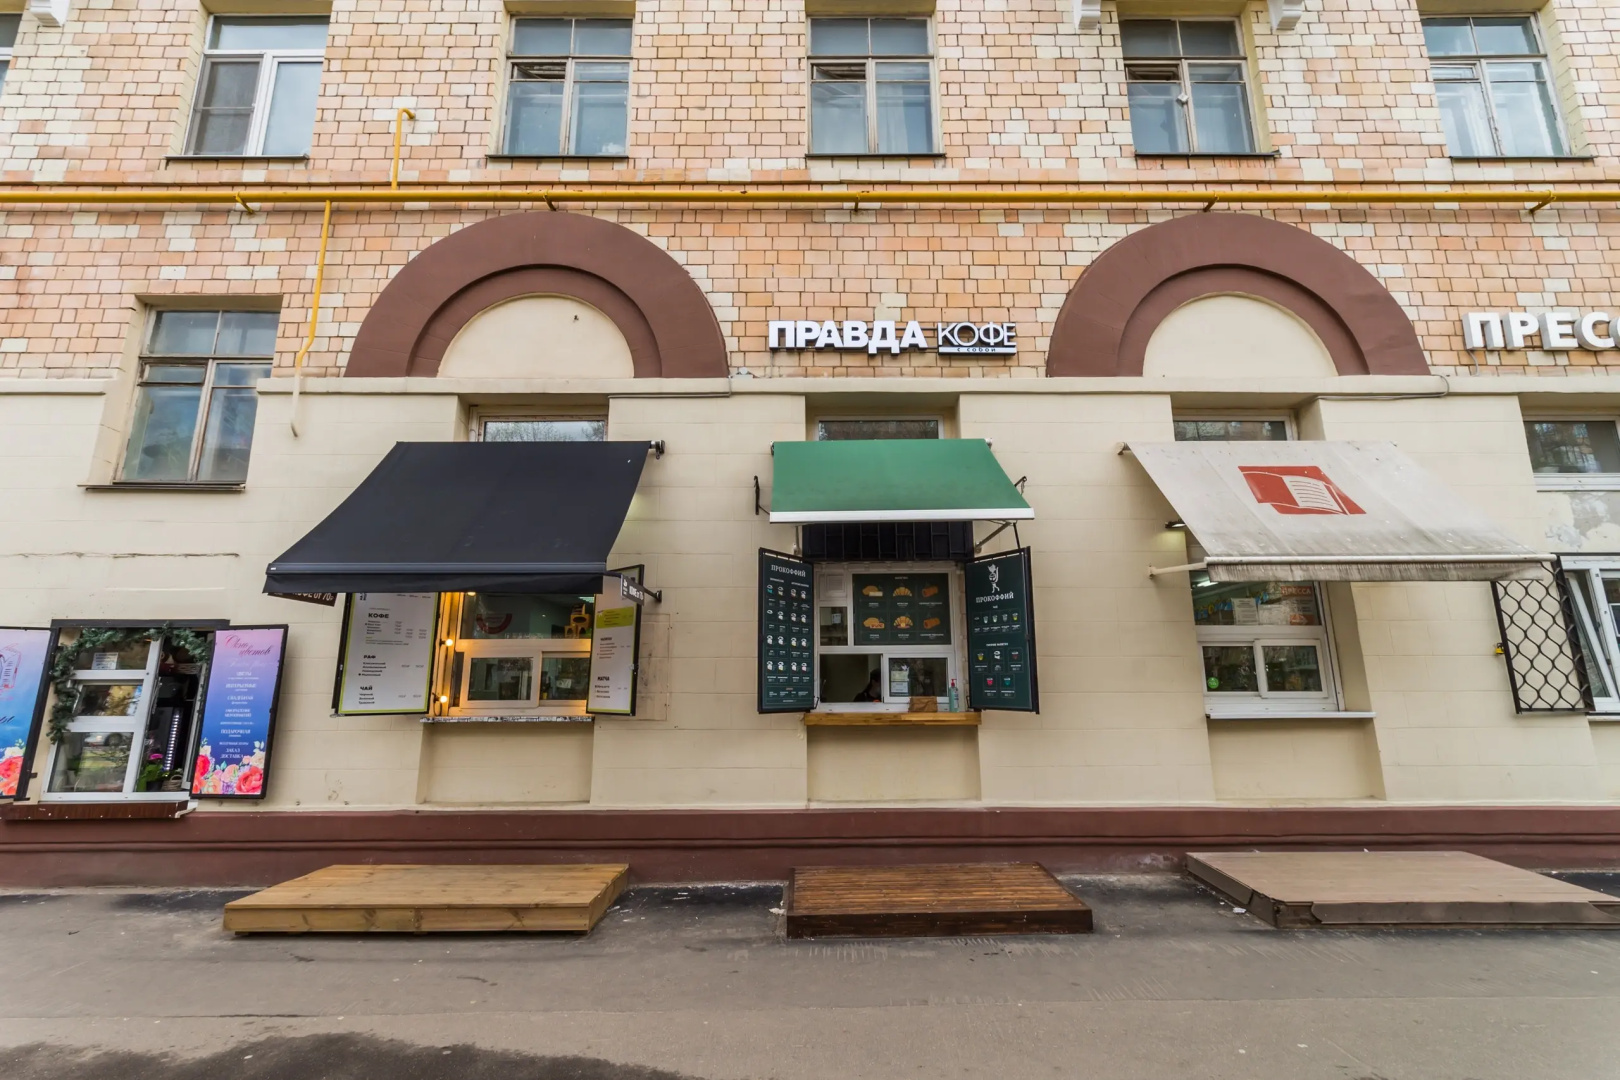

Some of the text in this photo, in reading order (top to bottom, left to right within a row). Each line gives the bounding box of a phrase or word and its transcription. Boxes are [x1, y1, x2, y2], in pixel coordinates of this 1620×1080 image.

[769, 321, 1017, 354] ПРАВДА КОФЕ
[1462, 311, 1620, 351] ПРЕС
[771, 564, 806, 578] ПРОКОФФИЙ
[975, 591, 1014, 603] ПРОКОФФИЙ
